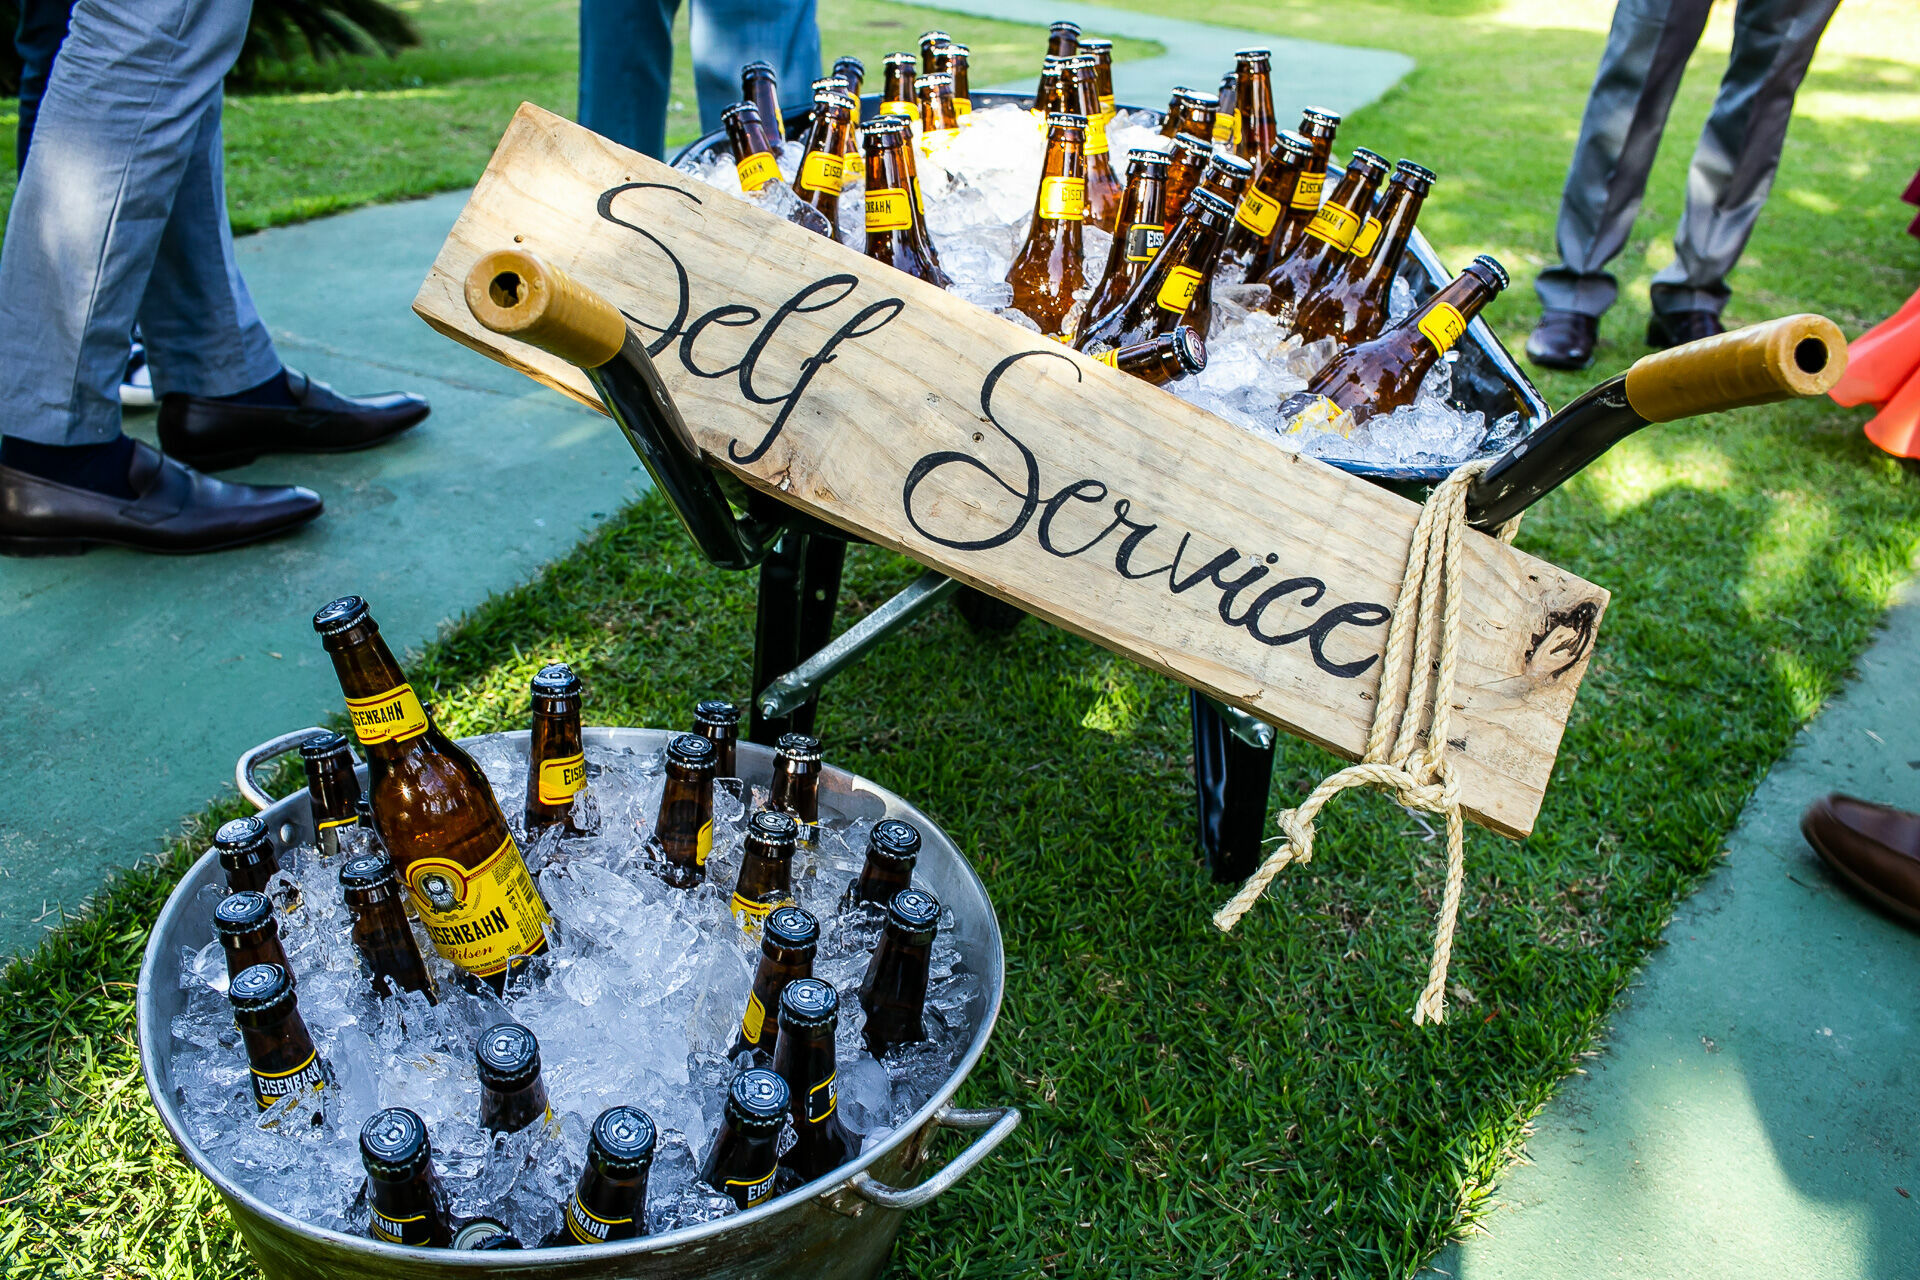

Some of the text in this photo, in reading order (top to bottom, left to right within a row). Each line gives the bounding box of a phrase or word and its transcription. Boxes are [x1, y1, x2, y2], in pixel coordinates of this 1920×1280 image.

[597, 182, 1391, 678] Self Service
[447, 944, 495, 961] Pilsen
